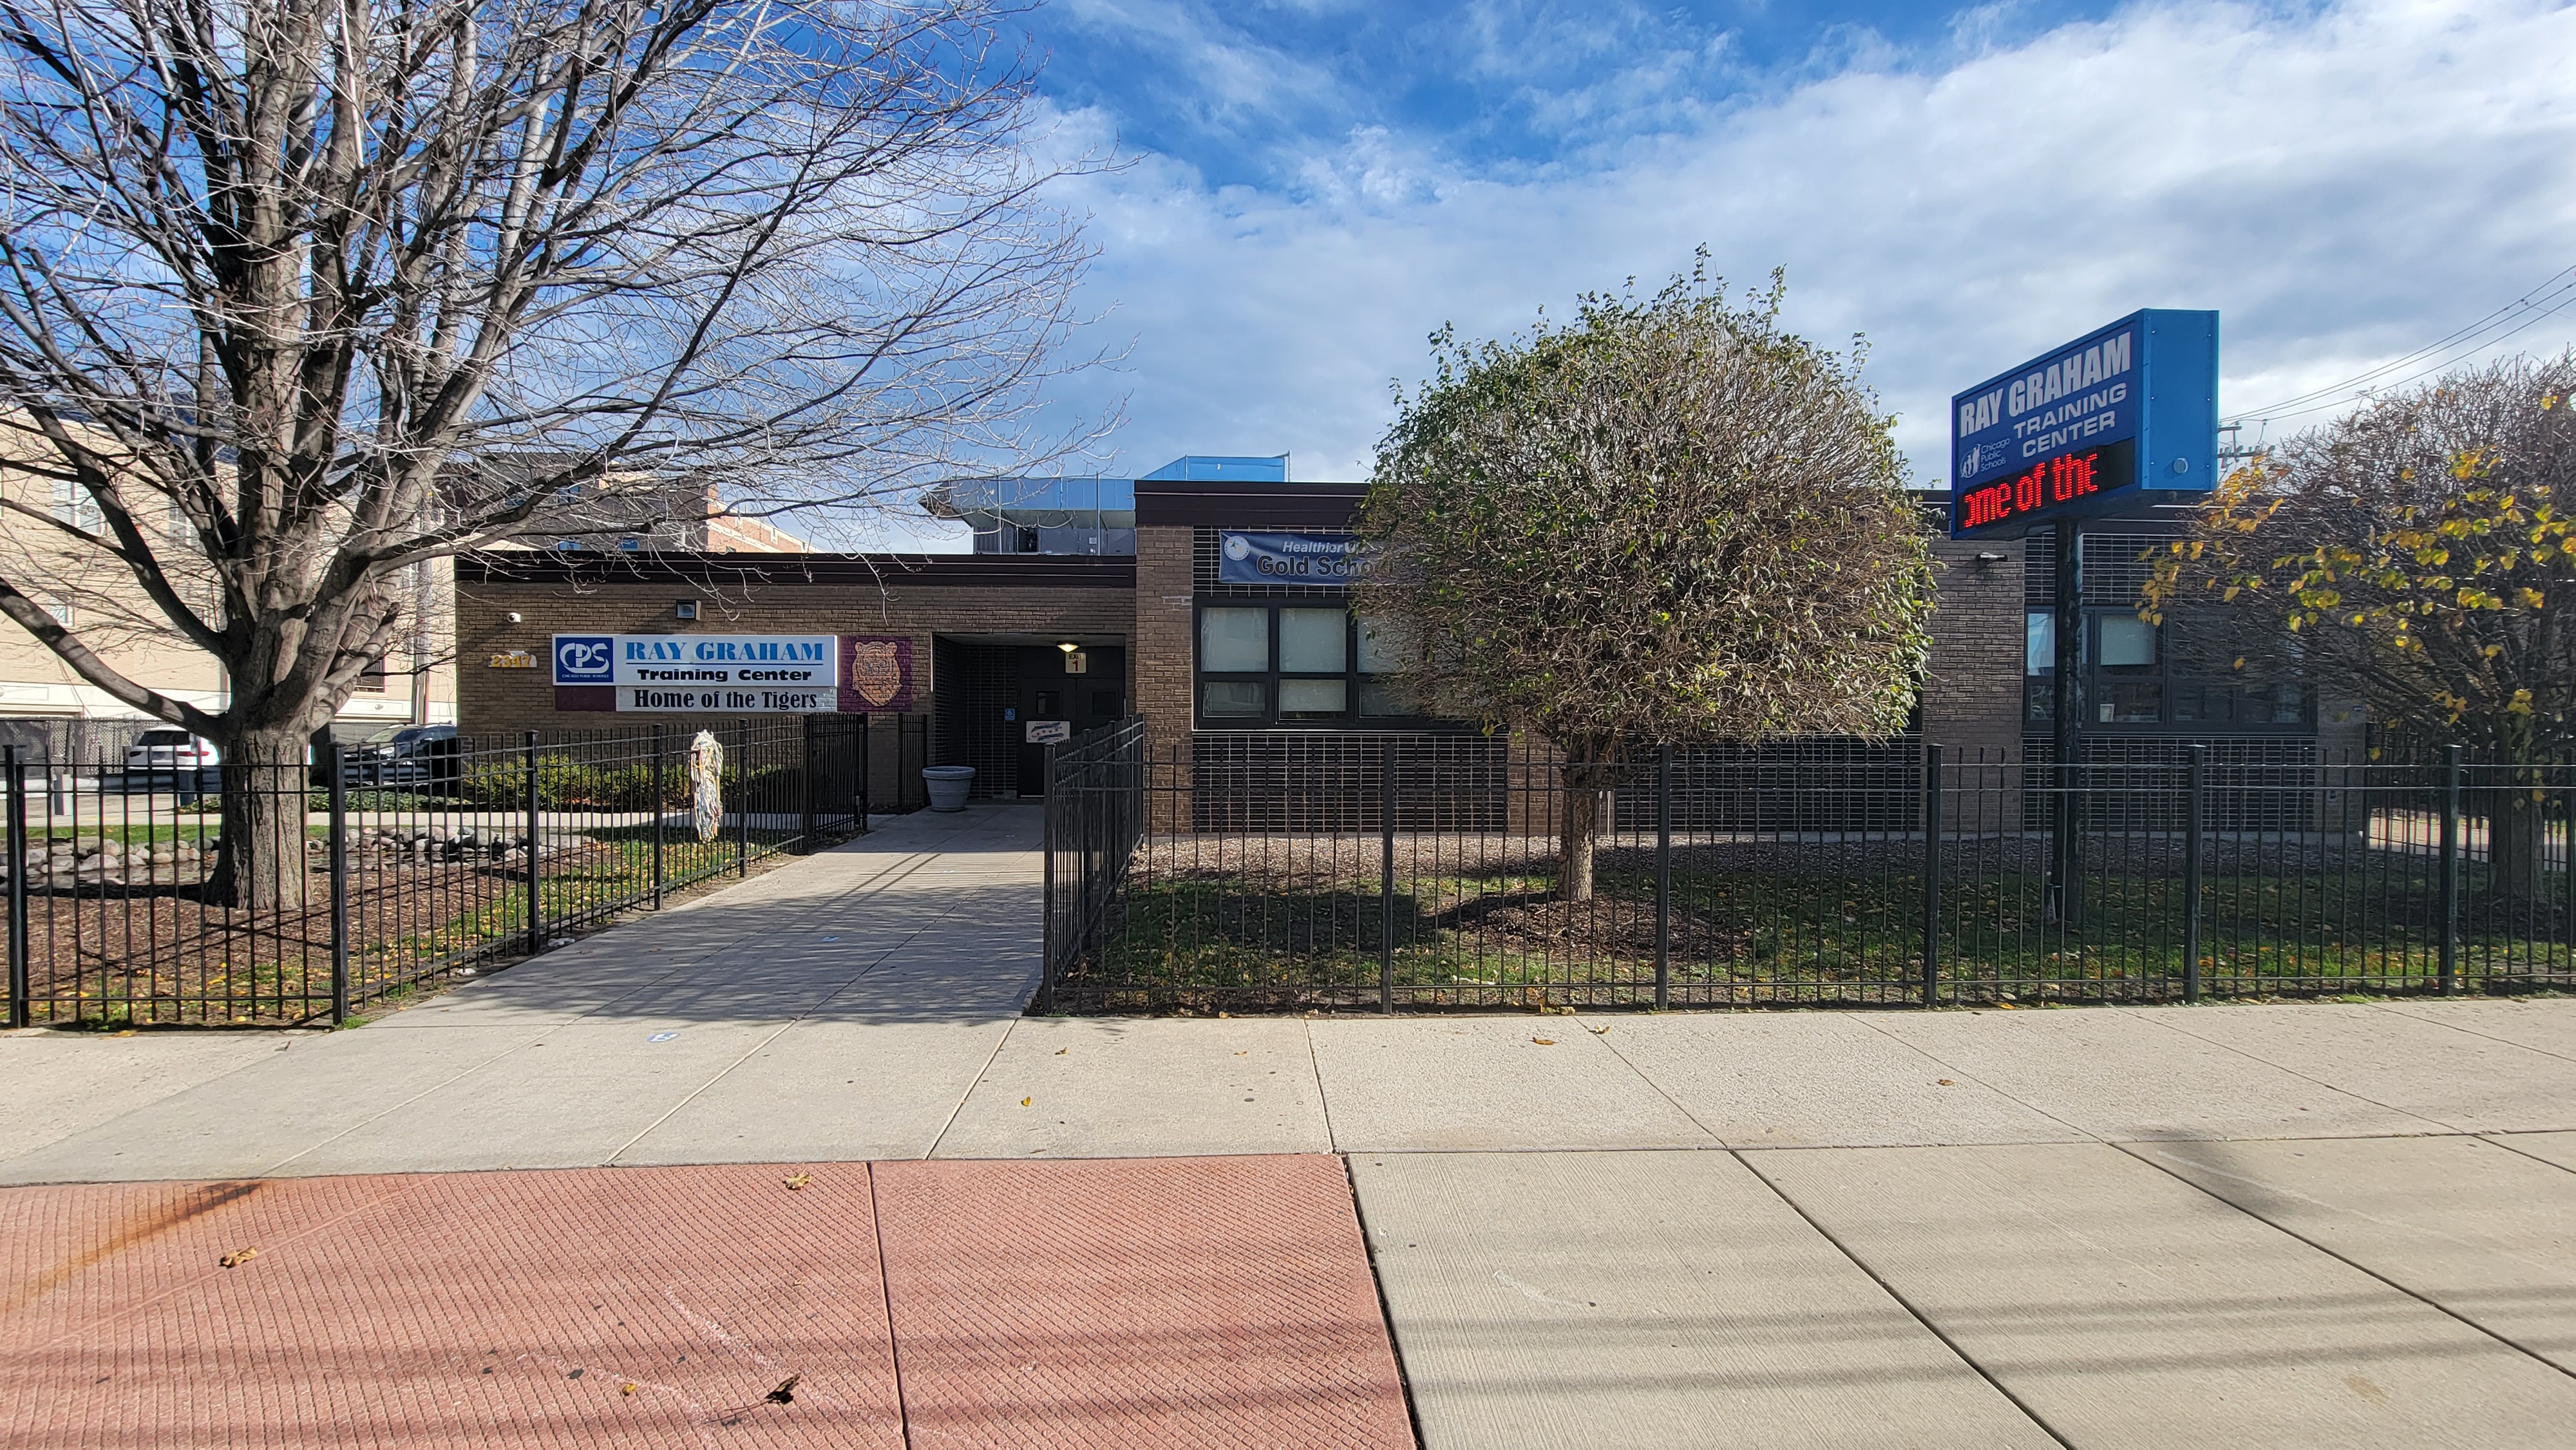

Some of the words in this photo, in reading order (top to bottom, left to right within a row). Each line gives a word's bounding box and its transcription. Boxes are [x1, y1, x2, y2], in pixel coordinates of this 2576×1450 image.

[1960, 388, 2003, 438] RAY
[2009, 331, 2131, 417] GRAHAM
[2014, 382, 2126, 438] TRAINING
[2023, 410, 2115, 458] CENTER
[1981, 438, 2010, 453] Chicago
[1981, 450, 2001, 463] Public
[1981, 457, 2006, 472] Schools
[2016, 462, 2046, 512] of
[1256, 555, 1310, 576] Gold
[491, 654, 531, 668] 2347
[560, 642, 609, 673] CPS
[625, 642, 687, 660] RAY
[696, 642, 824, 661] GRAHAM
[638, 669, 728, 683] Training
[738, 669, 811, 681] Center
[1072, 660, 1079, 672] 1
[634, 689, 694, 708] Home
[701, 691, 719, 708] of
[726, 691, 755, 708] the
[761, 691, 817, 710] Tigers
